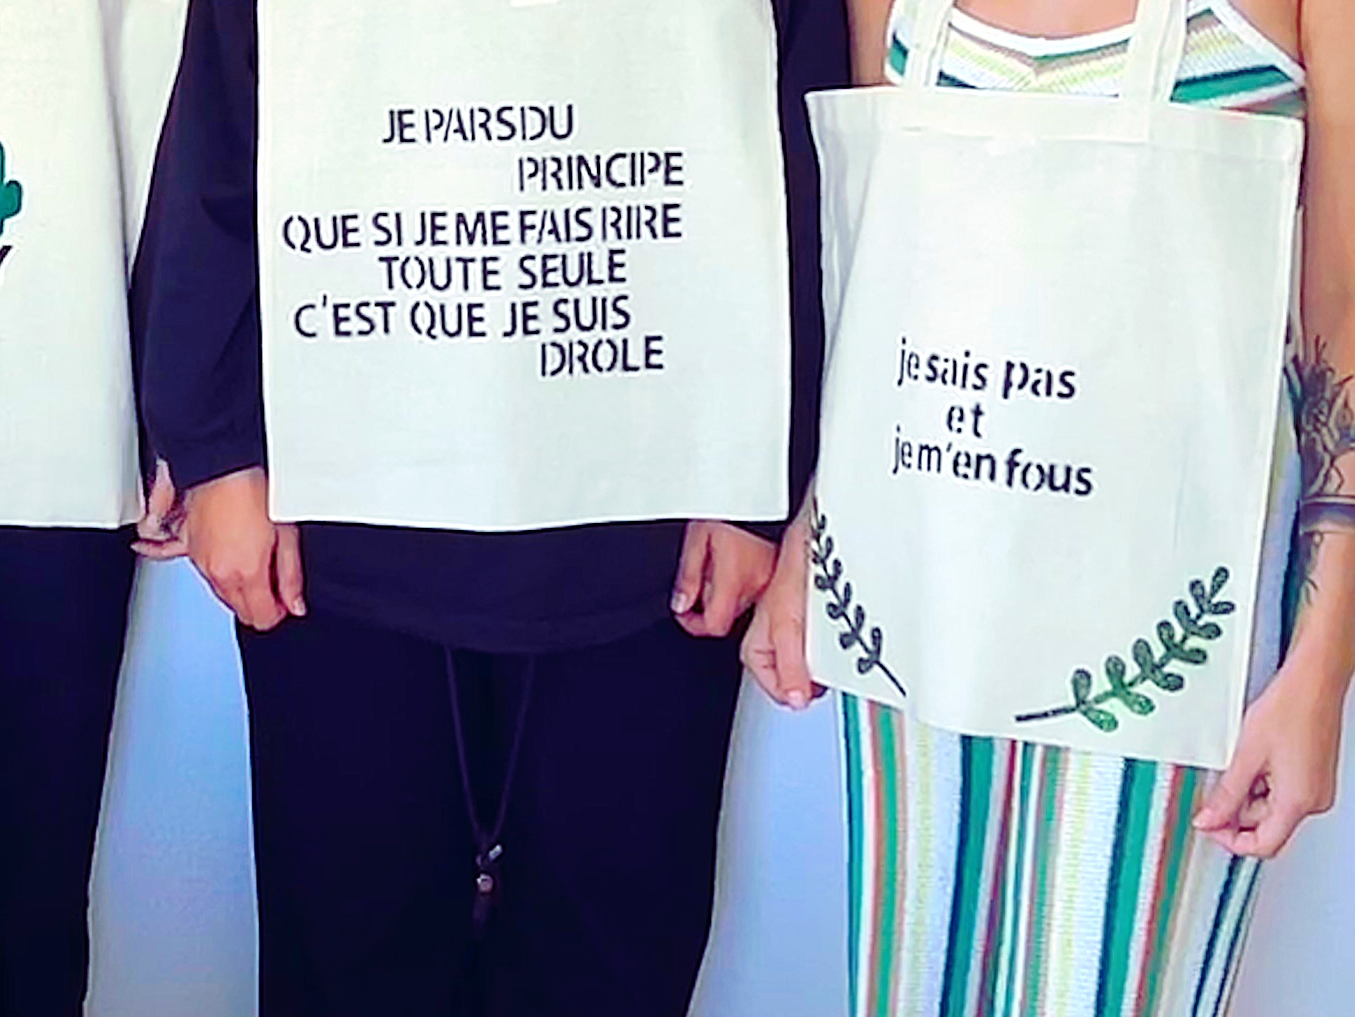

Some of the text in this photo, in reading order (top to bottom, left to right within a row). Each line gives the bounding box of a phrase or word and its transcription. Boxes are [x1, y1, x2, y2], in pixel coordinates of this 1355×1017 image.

[382, 104, 573, 144] JE PARS DU
[518, 151, 684, 192] PRINCIPE
[283, 203, 682, 253] QUE SI JE ME FAIS RIRE
[378, 248, 627, 291] TOUTE SEULE
[294, 294, 631, 340] C'EST QUE JE SUIS
[541, 335, 664, 377] DROLE
[897, 337, 1076, 400] je sais pas
[946, 403, 984, 438] et
[892, 425, 1093, 496] je m'en fous
